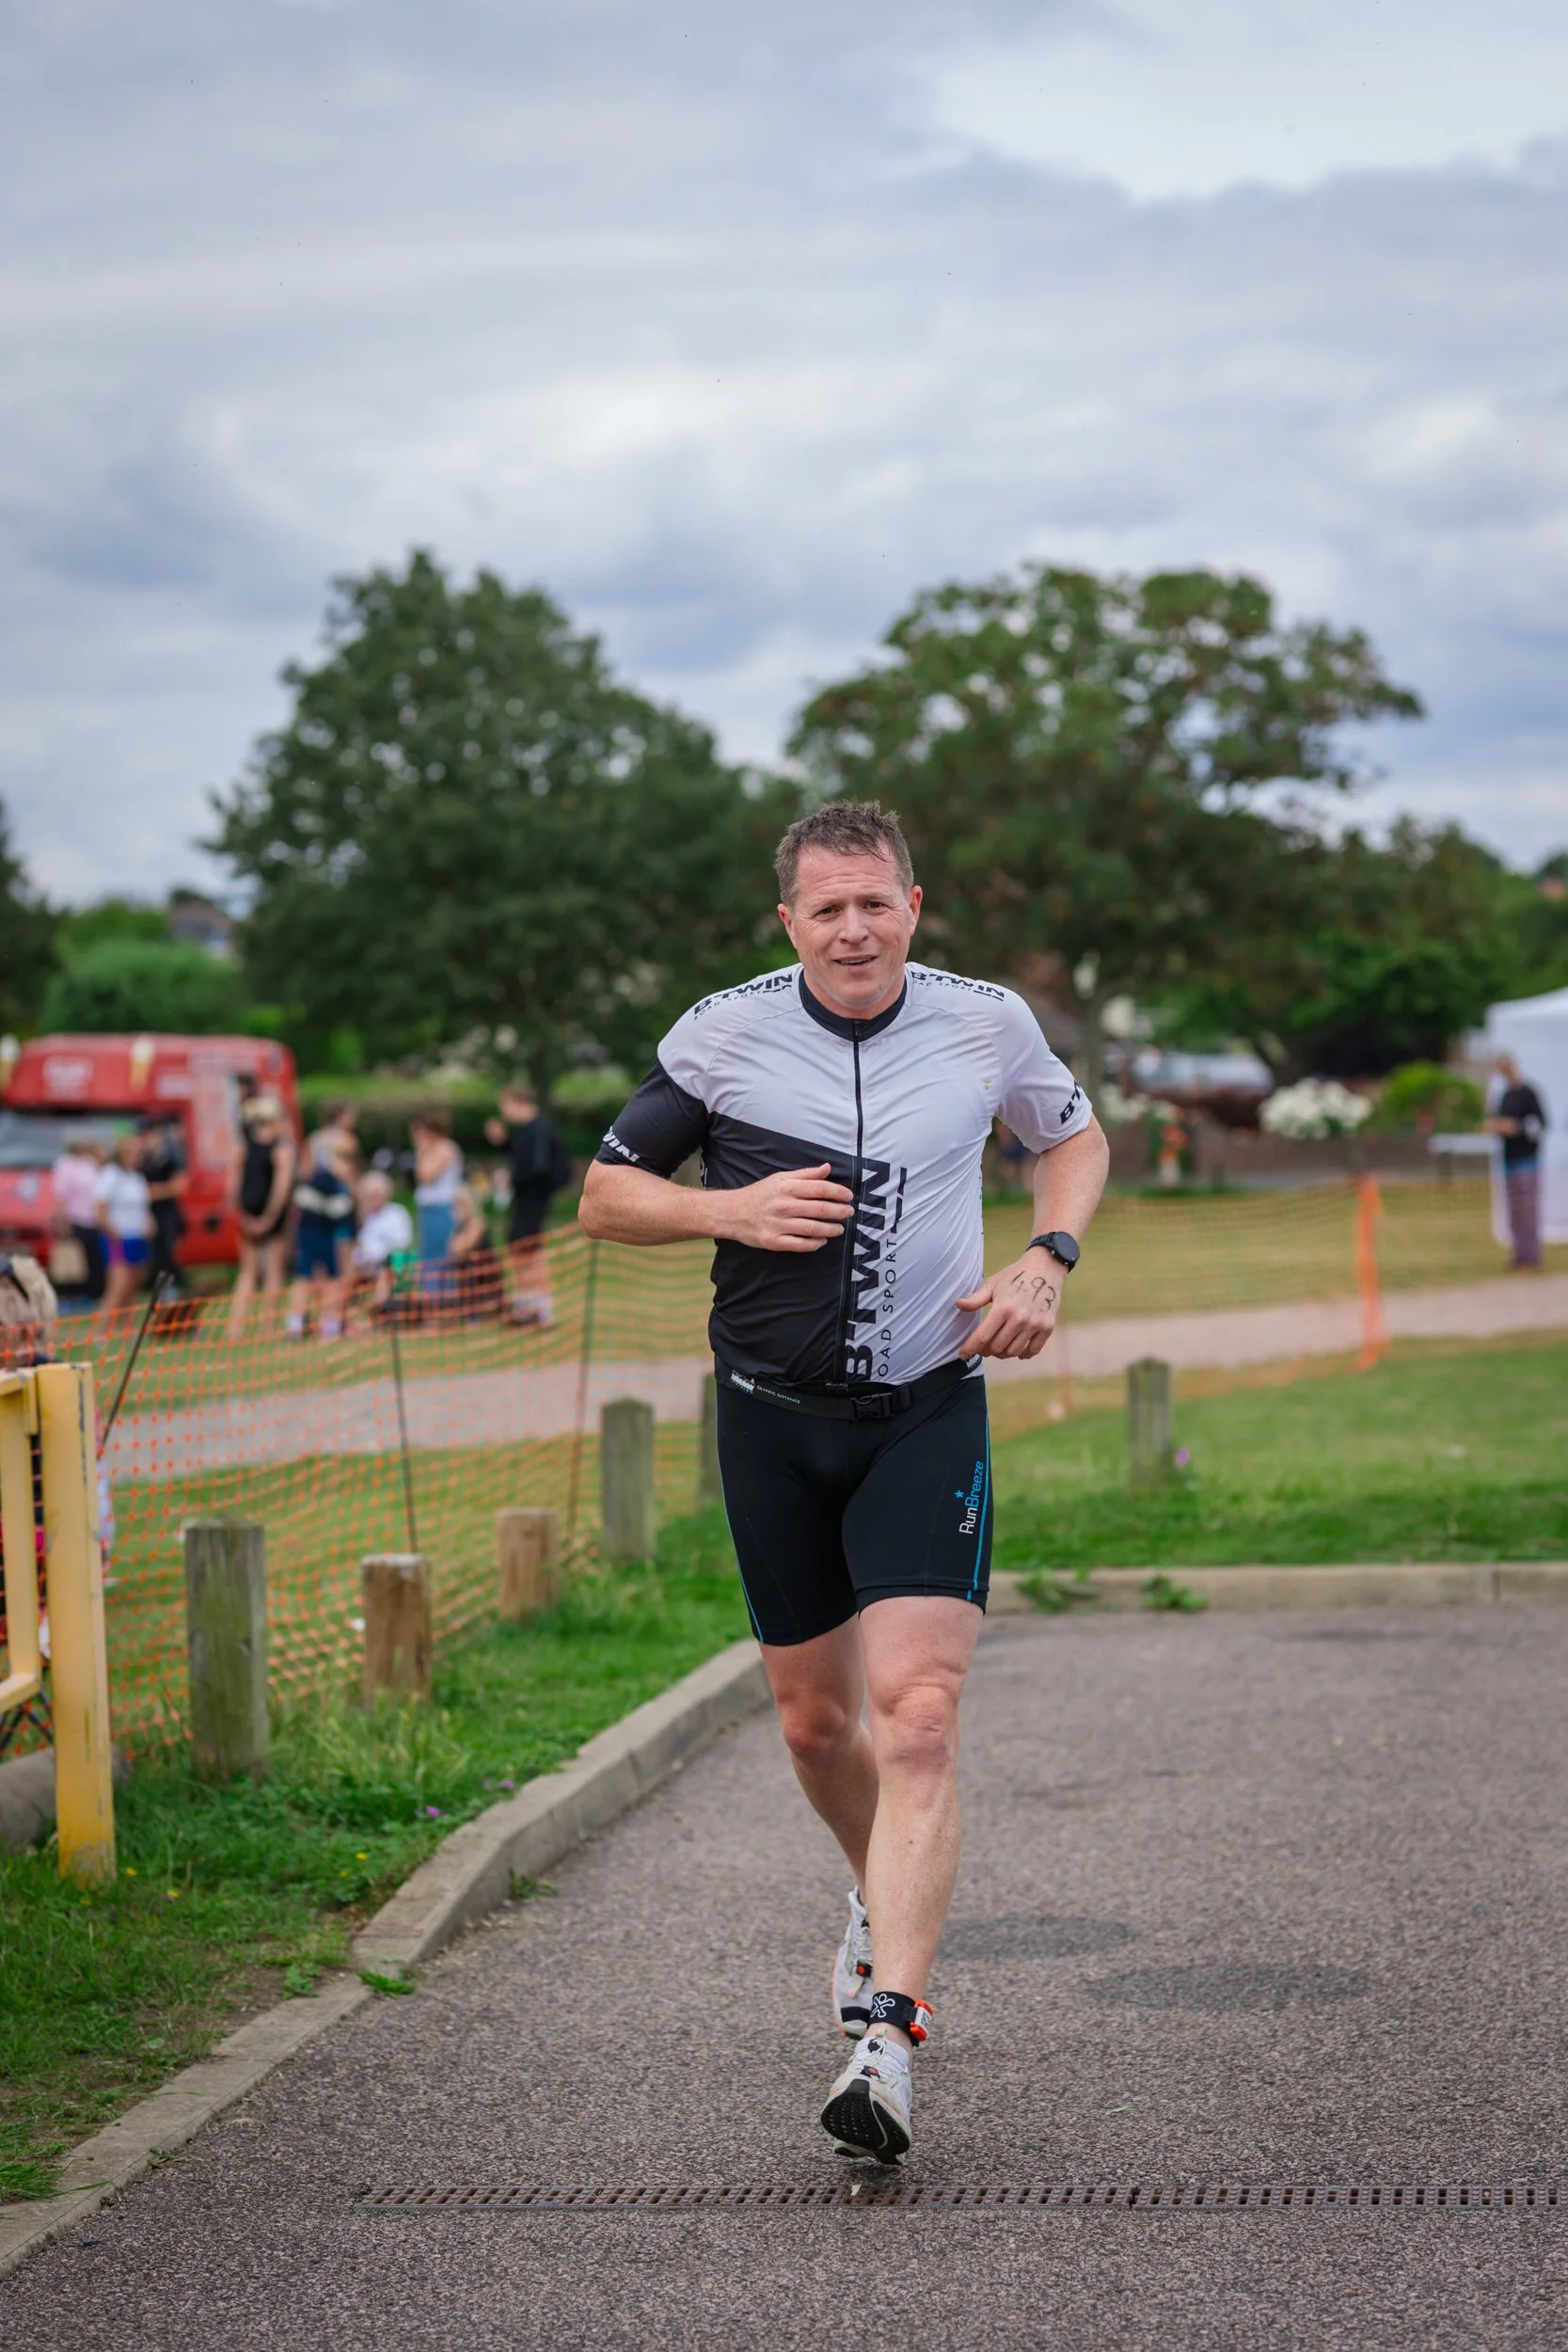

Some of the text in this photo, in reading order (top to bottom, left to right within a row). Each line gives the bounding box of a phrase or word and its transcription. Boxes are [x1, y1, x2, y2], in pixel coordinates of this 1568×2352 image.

[878, 1238, 897, 1377] OAD SPORT
[756, 1385, 800, 1404] OLYMPIC DISTANCE
[958, 1460, 984, 1534] RunBreeze
